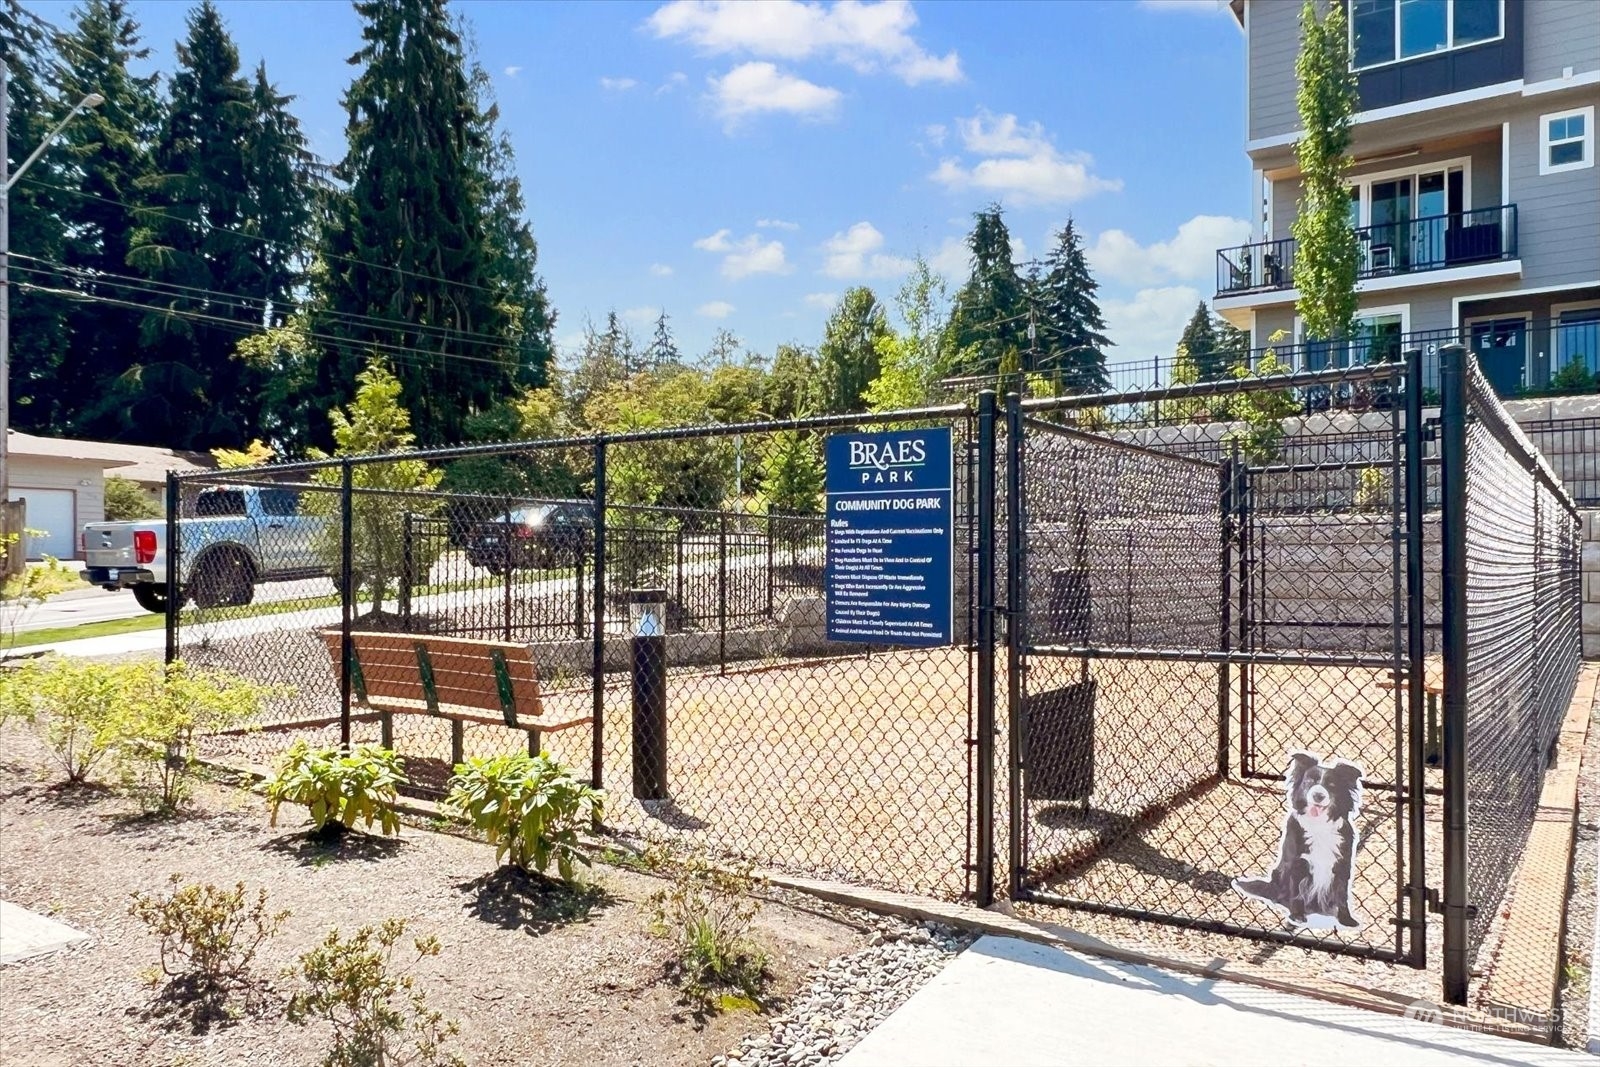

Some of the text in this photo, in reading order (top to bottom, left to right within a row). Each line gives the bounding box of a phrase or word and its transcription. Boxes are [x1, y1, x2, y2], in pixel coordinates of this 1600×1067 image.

[849, 440, 926, 470] BRAES
[862, 470, 913, 484] PARK
[836, 498, 940, 511] COMMUNITY DOG PARK
[831, 519, 848, 528] Rules
